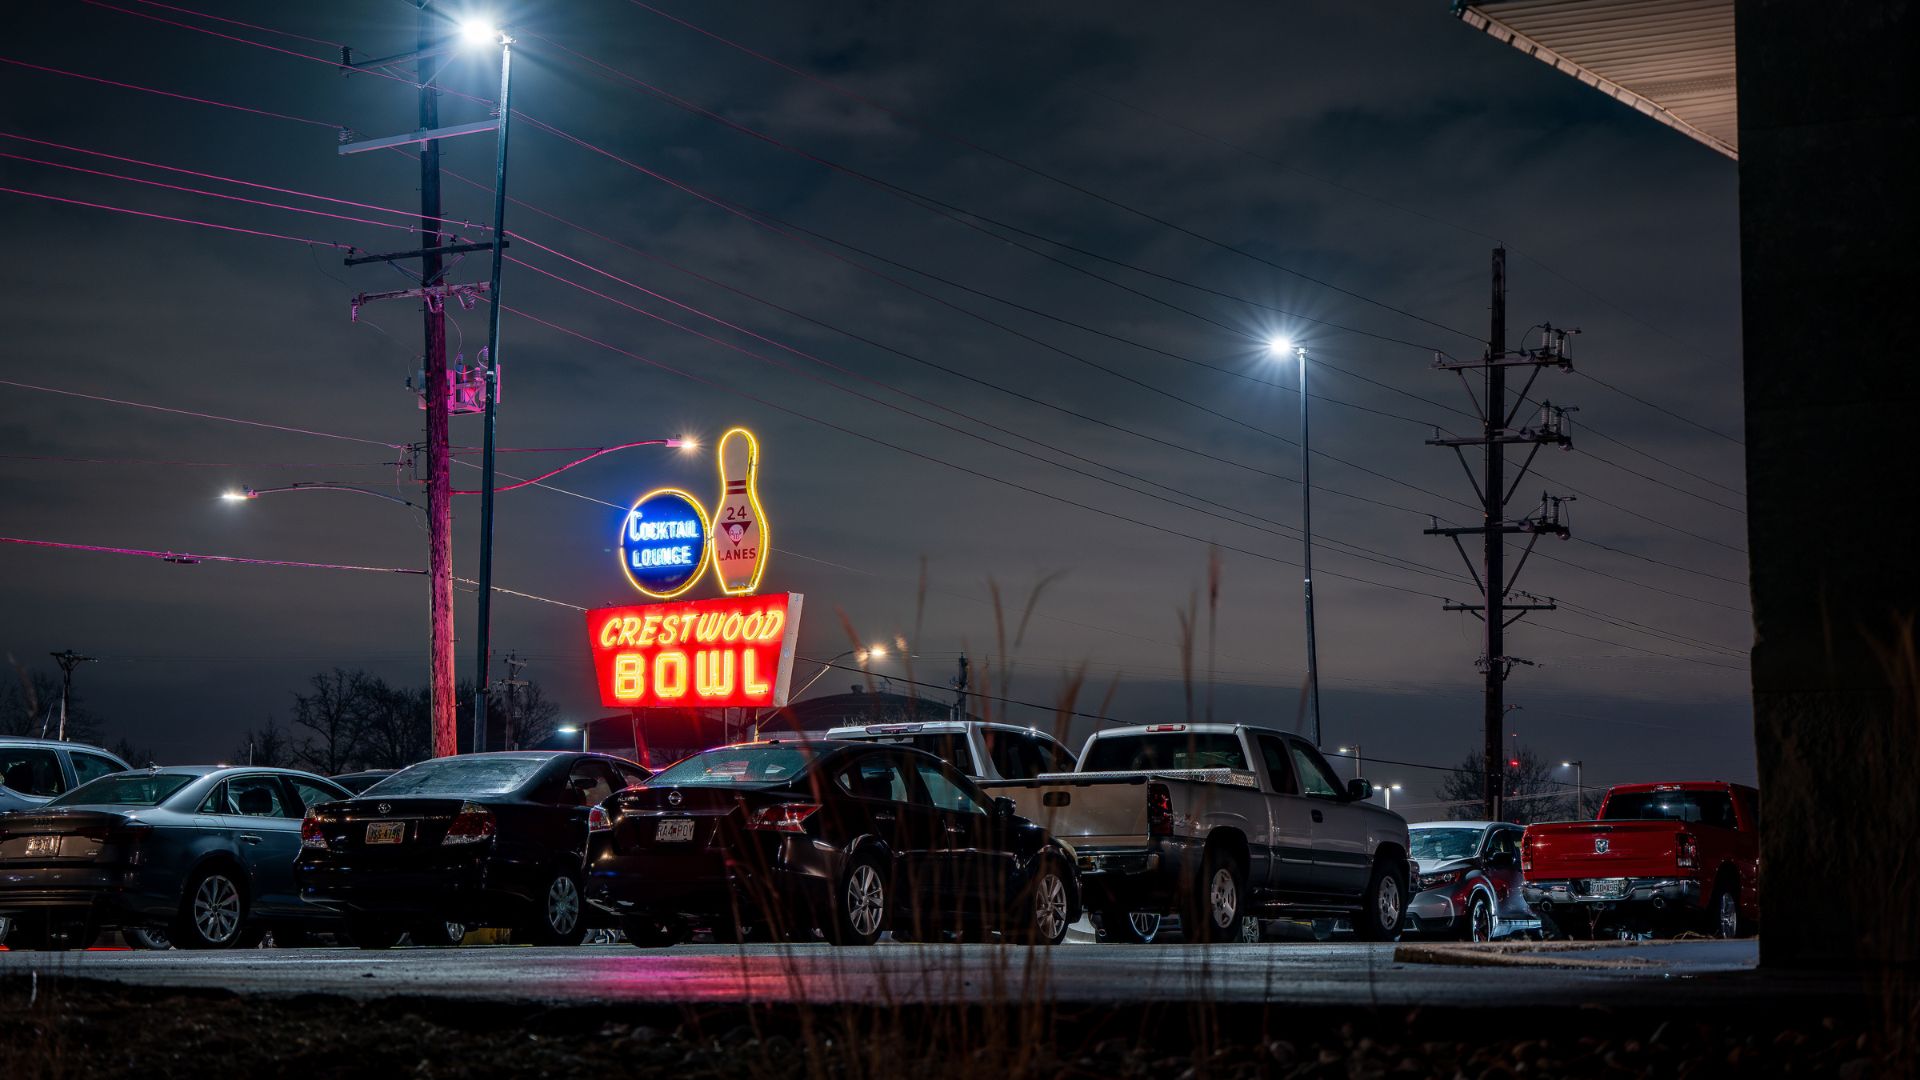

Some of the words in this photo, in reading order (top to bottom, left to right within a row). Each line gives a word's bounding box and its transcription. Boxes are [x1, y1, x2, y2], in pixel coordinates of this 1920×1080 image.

[726, 505, 748, 520] 24
[629, 511, 699, 541] COCKTAIL
[633, 546, 692, 567] LOUNGE
[718, 547, 756, 561] LANES
[601, 610, 784, 646] CRESTWOOD
[615, 649, 768, 698] BOWL
